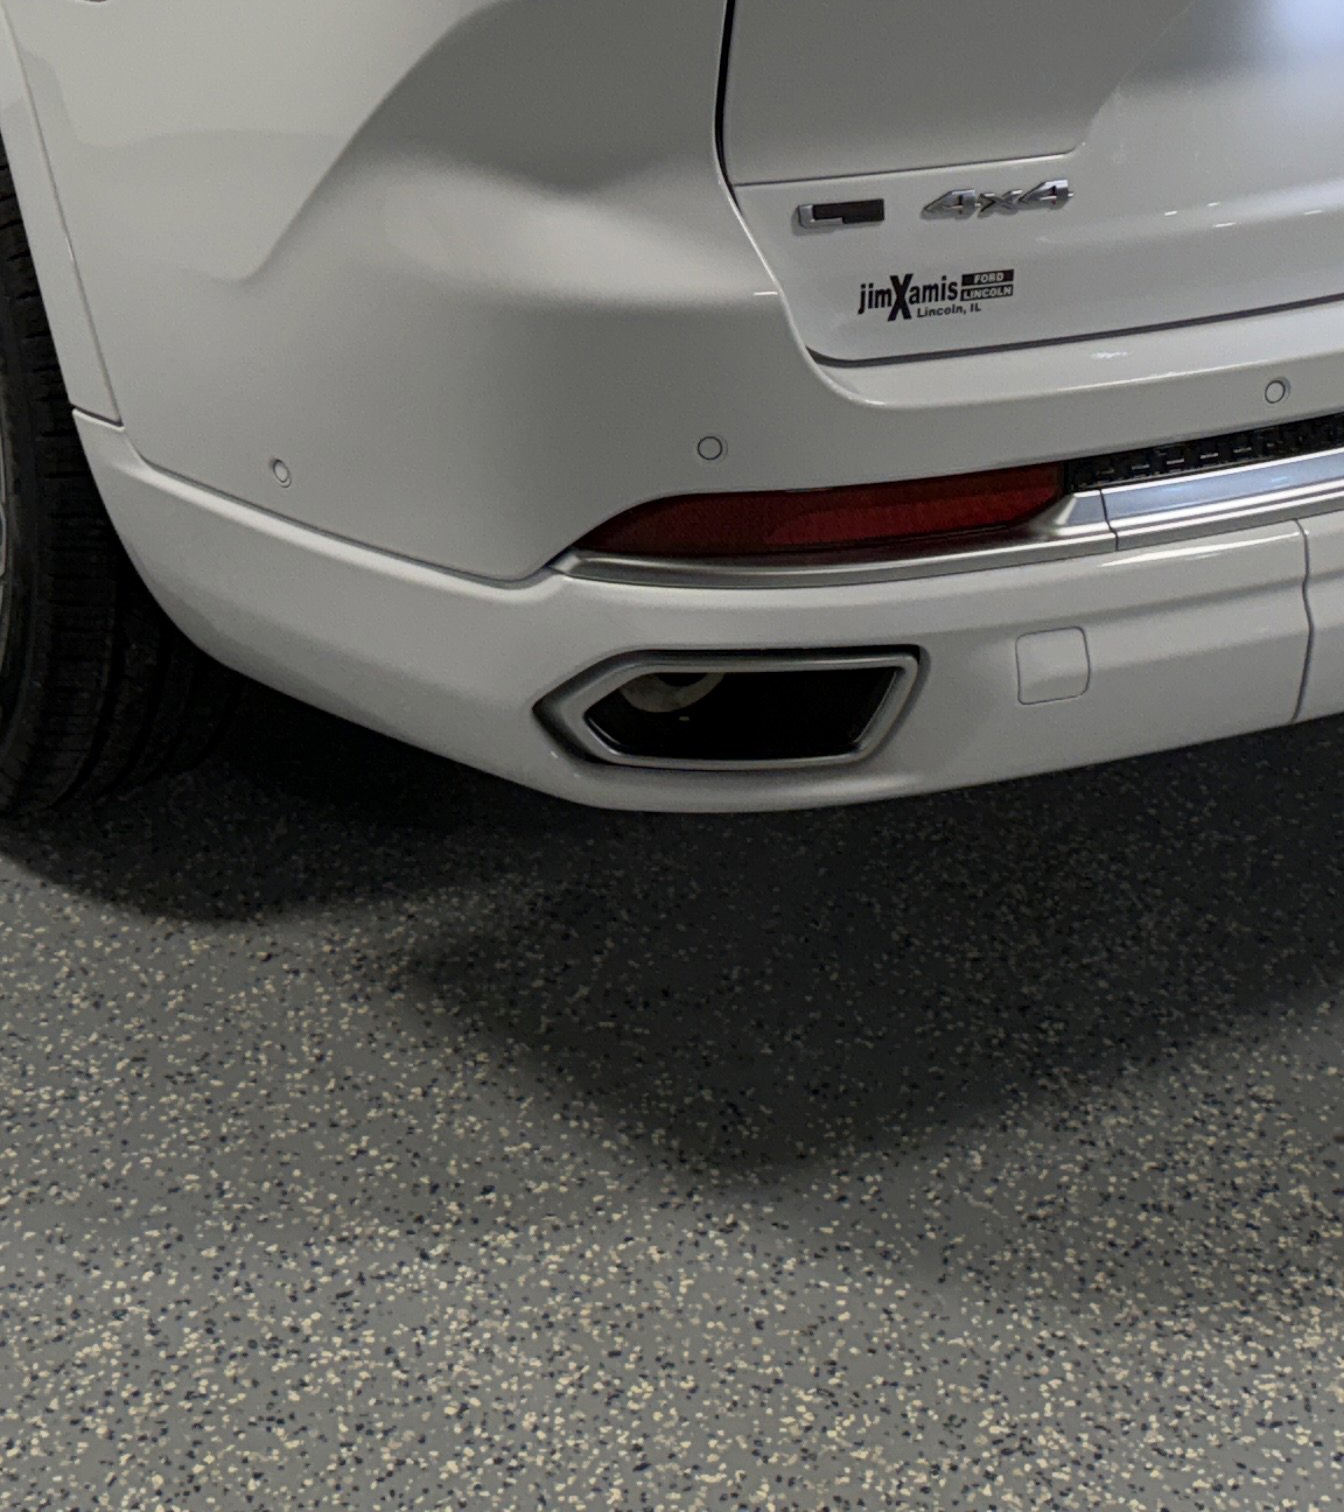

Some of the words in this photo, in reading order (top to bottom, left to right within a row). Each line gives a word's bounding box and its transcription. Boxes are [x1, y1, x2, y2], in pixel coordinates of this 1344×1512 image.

[973, 272, 1004, 284] FORD
[857, 273, 959, 322] jimXamis
[962, 286, 1012, 300] LINCOLN
[917, 303, 967, 318] Lincoln,
[970, 302, 982, 313] IL
